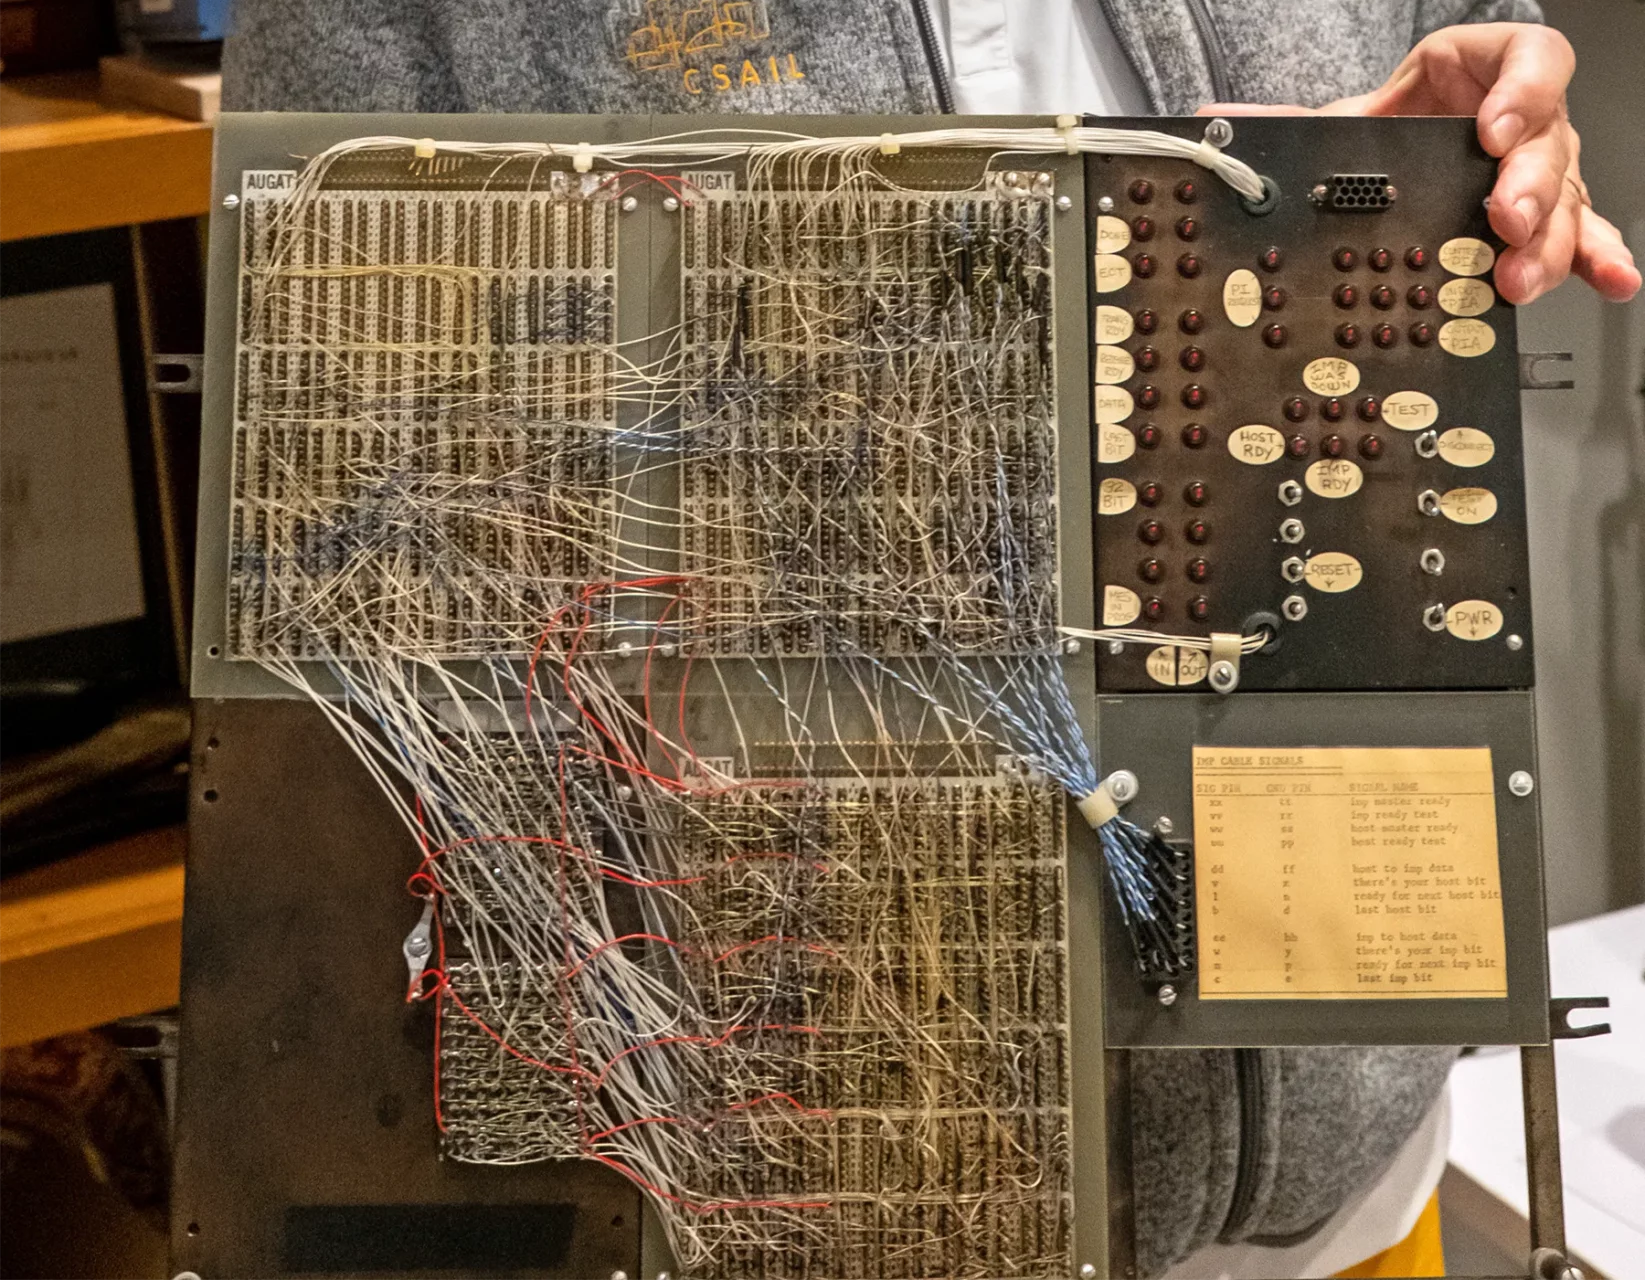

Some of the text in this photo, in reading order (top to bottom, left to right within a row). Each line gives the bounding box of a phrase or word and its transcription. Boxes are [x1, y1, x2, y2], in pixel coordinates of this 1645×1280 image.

[684, 53, 806, 94] CSAIL
[247, 173, 294, 190] AUGAT
[685, 173, 732, 190] AUGAT
[1310, 361, 1349, 373] IMP
[1310, 371, 1347, 381] WAS
[1311, 380, 1351, 392] DOWN
[1388, 403, 1430, 416] TEST
[1240, 431, 1278, 444] HOST
[1243, 443, 1274, 461] RDY
[1316, 464, 1351, 476] IMP
[1322, 477, 1353, 492] RDY
[1103, 494, 1129, 508] BIT
[1456, 506, 1479, 517] ON
[1310, 563, 1354, 576] RESET
[1455, 610, 1494, 626] PWR
[1154, 662, 1171, 677] IN
[1181, 664, 1206, 678] OUT
[1196, 755, 1305, 766] IMP CABLE SIGNALS
[1196, 783, 1217, 793] SIG
[1221, 783, 1242, 793] PIN
[1291, 782, 1312, 793] PIN
[1348, 782, 1388, 793] SIGNAL
[1391, 782, 1419, 792] NAME
[1350, 797, 1369, 808] imp
[1374, 797, 1412, 806] master
[1420, 796, 1452, 808] ready
[1350, 810, 1370, 821] imp
[1375, 809, 1408, 821] ready
[1413, 810, 1440, 819] test
[1350, 823, 1377, 833] host
[1381, 823, 1421, 833] master
[1426, 822, 1459, 835] ready
[1280, 839, 1295, 850] pp
[1350, 836, 1377, 846] host
[1382, 836, 1416, 848] ready
[1421, 836, 1448, 846] test
[1210, 863, 1455, 875] dd ff host to imp data
[1353, 876, 1398, 887] there's
[1403, 878, 1430, 889] your
[1435, 876, 1461, 886] host
[1466, 876, 1487, 886] bit
[1353, 891, 1387, 902] ready
[1391, 890, 1411, 900] for
[1417, 891, 1443, 900] next
[1448, 890, 1475, 900] host
[1480, 889, 1501, 900] bit
[1355, 904, 1380, 914] last
[1385, 904, 1412, 914] host
[1417, 904, 1438, 914] bit
[1356, 932, 1375, 944] imp
[1380, 932, 1395, 941] to
[1399, 931, 1426, 941] host
[1431, 931, 1458, 941] data
[1355, 945, 1401, 956] there's
[1407, 947, 1433, 957] your
[1439, 945, 1458, 957] imp
[1463, 944, 1484, 954] bit
[1355, 960, 1389, 972] ready
[1395, 959, 1413, 969] for
[1419, 960, 1446, 969] next
[1451, 959, 1471, 971] imp
[1476, 958, 1497, 969] bit
[1356, 973, 1382, 983] last
[1389, 972, 1409, 985] imp
[1412, 972, 1434, 982] bit
